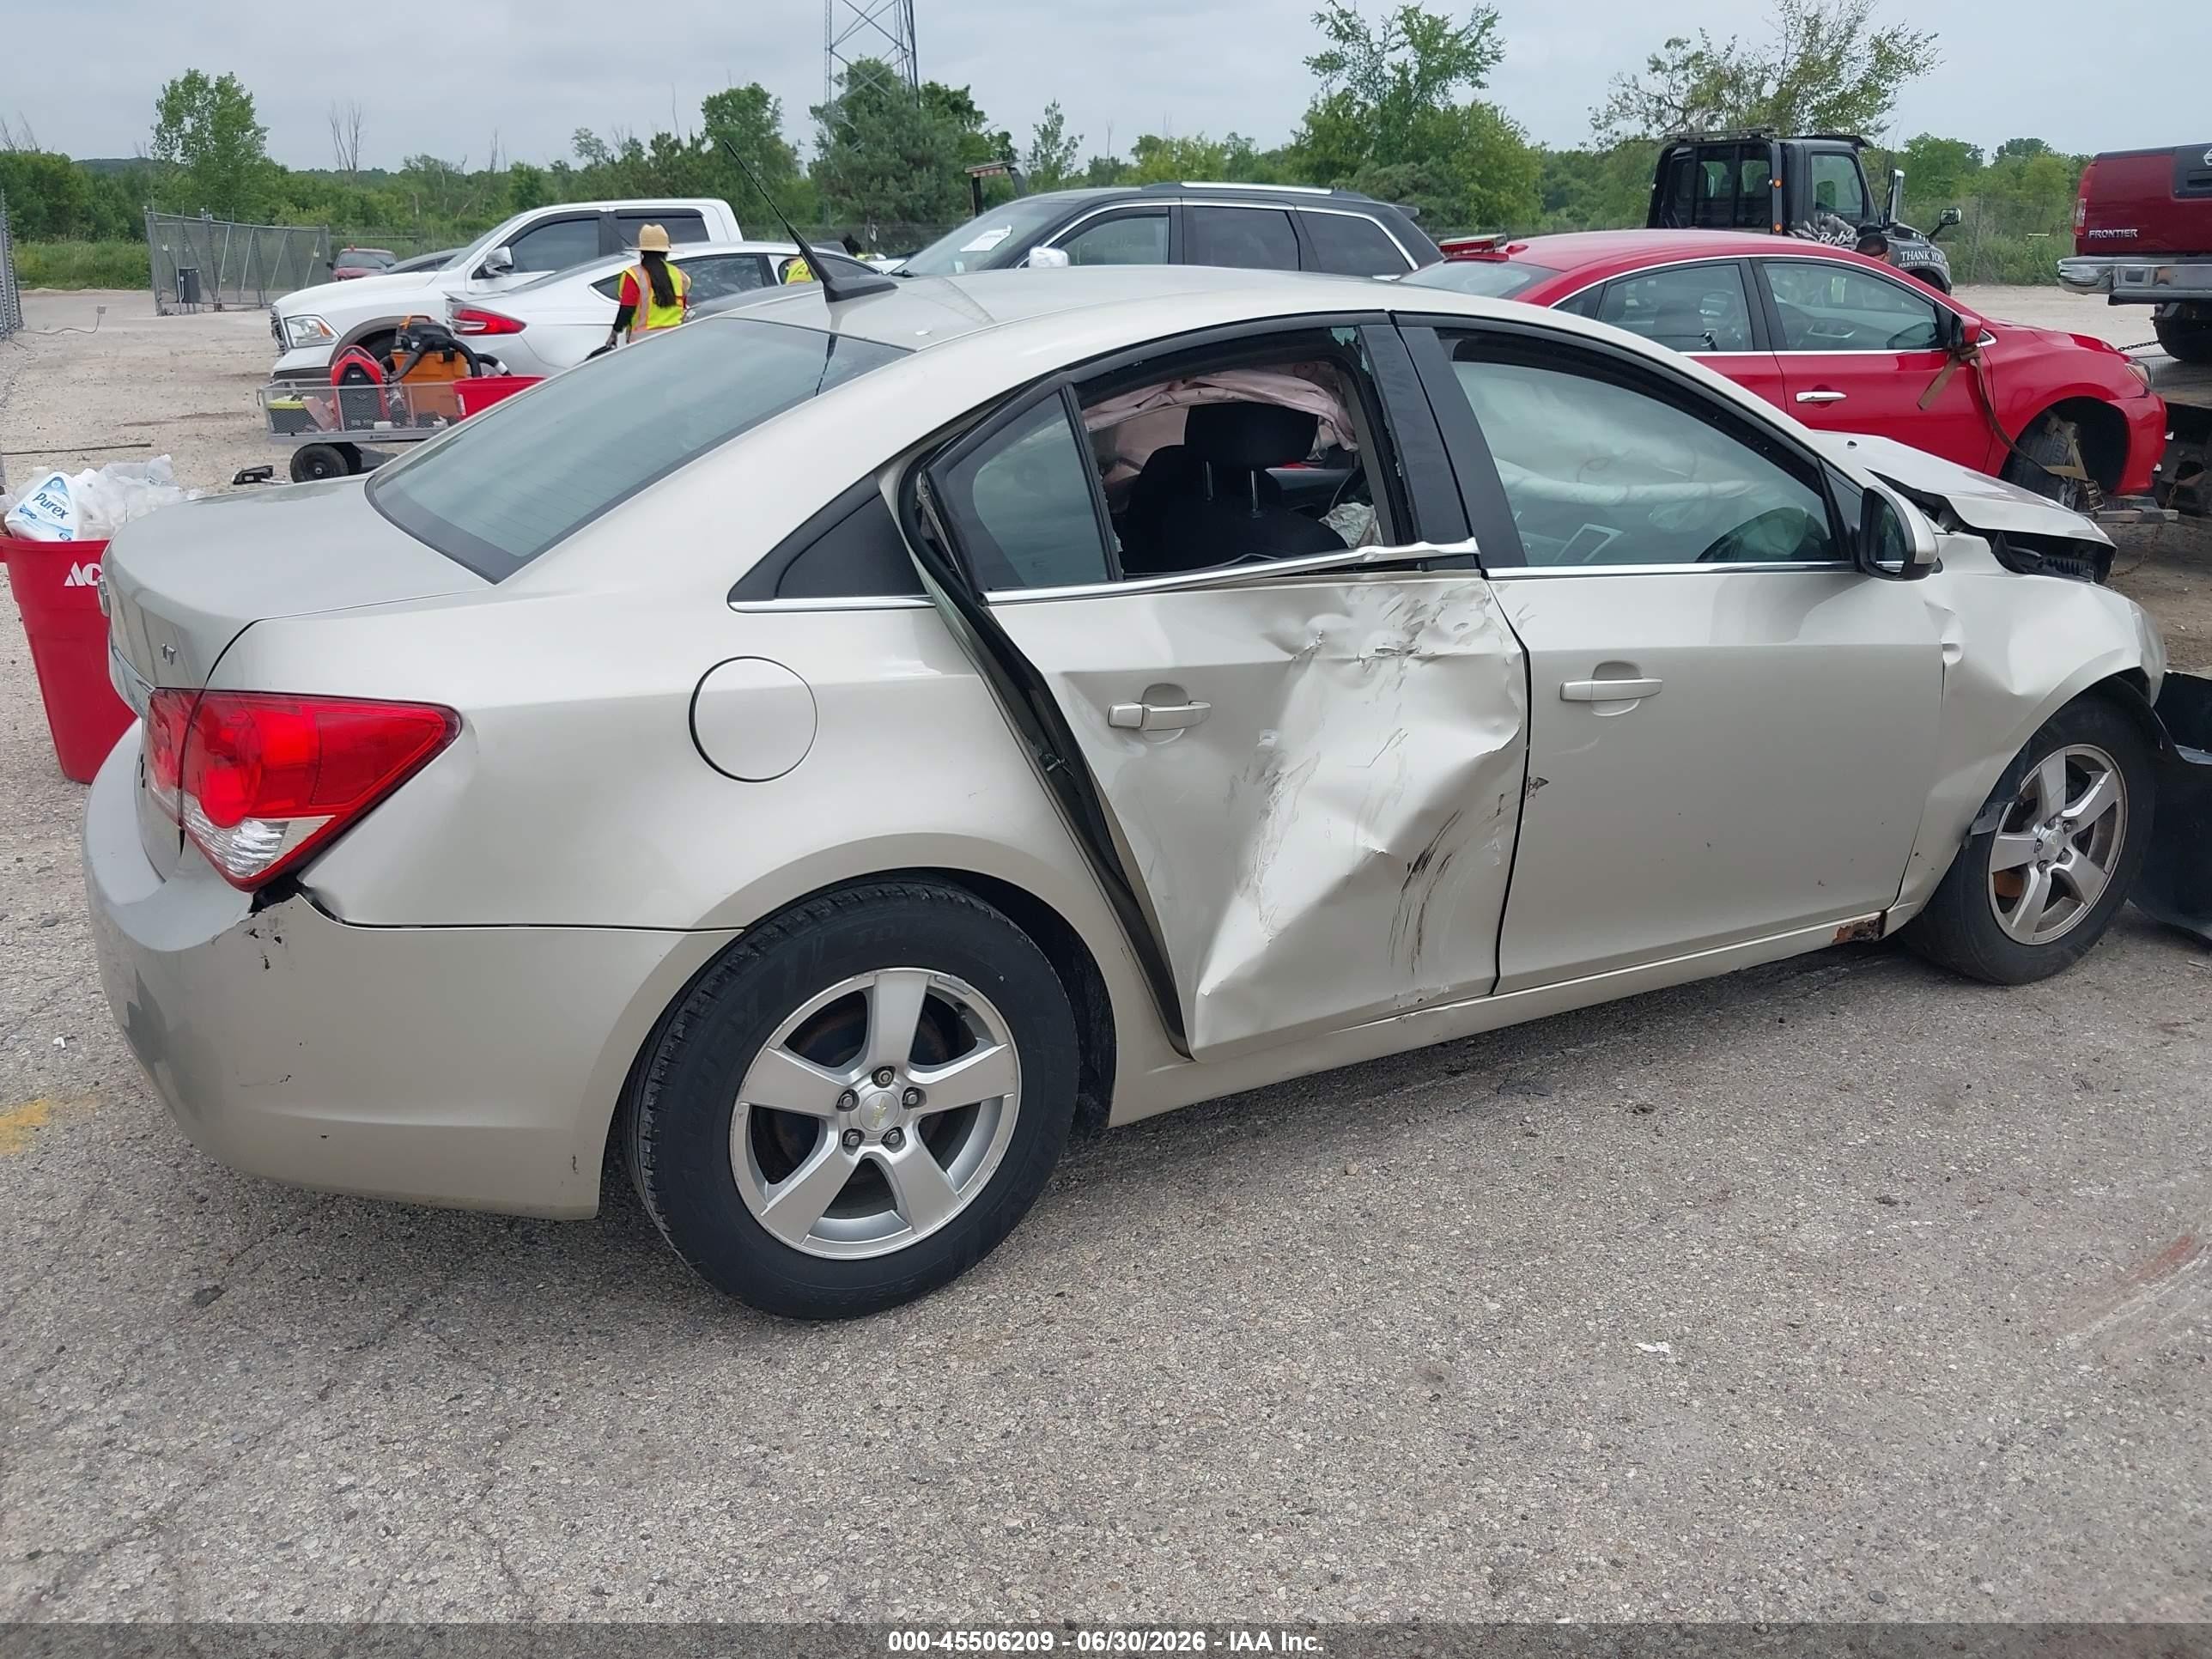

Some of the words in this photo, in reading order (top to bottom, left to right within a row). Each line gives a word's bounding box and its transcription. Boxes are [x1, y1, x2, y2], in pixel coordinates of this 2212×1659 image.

[2088, 228, 2138, 239] FRONTIER
[1900, 250, 1930, 261] THANK
[1930, 252, 1944, 264] YOU
[32, 492, 70, 520] Purex
[64, 561, 102, 586] AC
